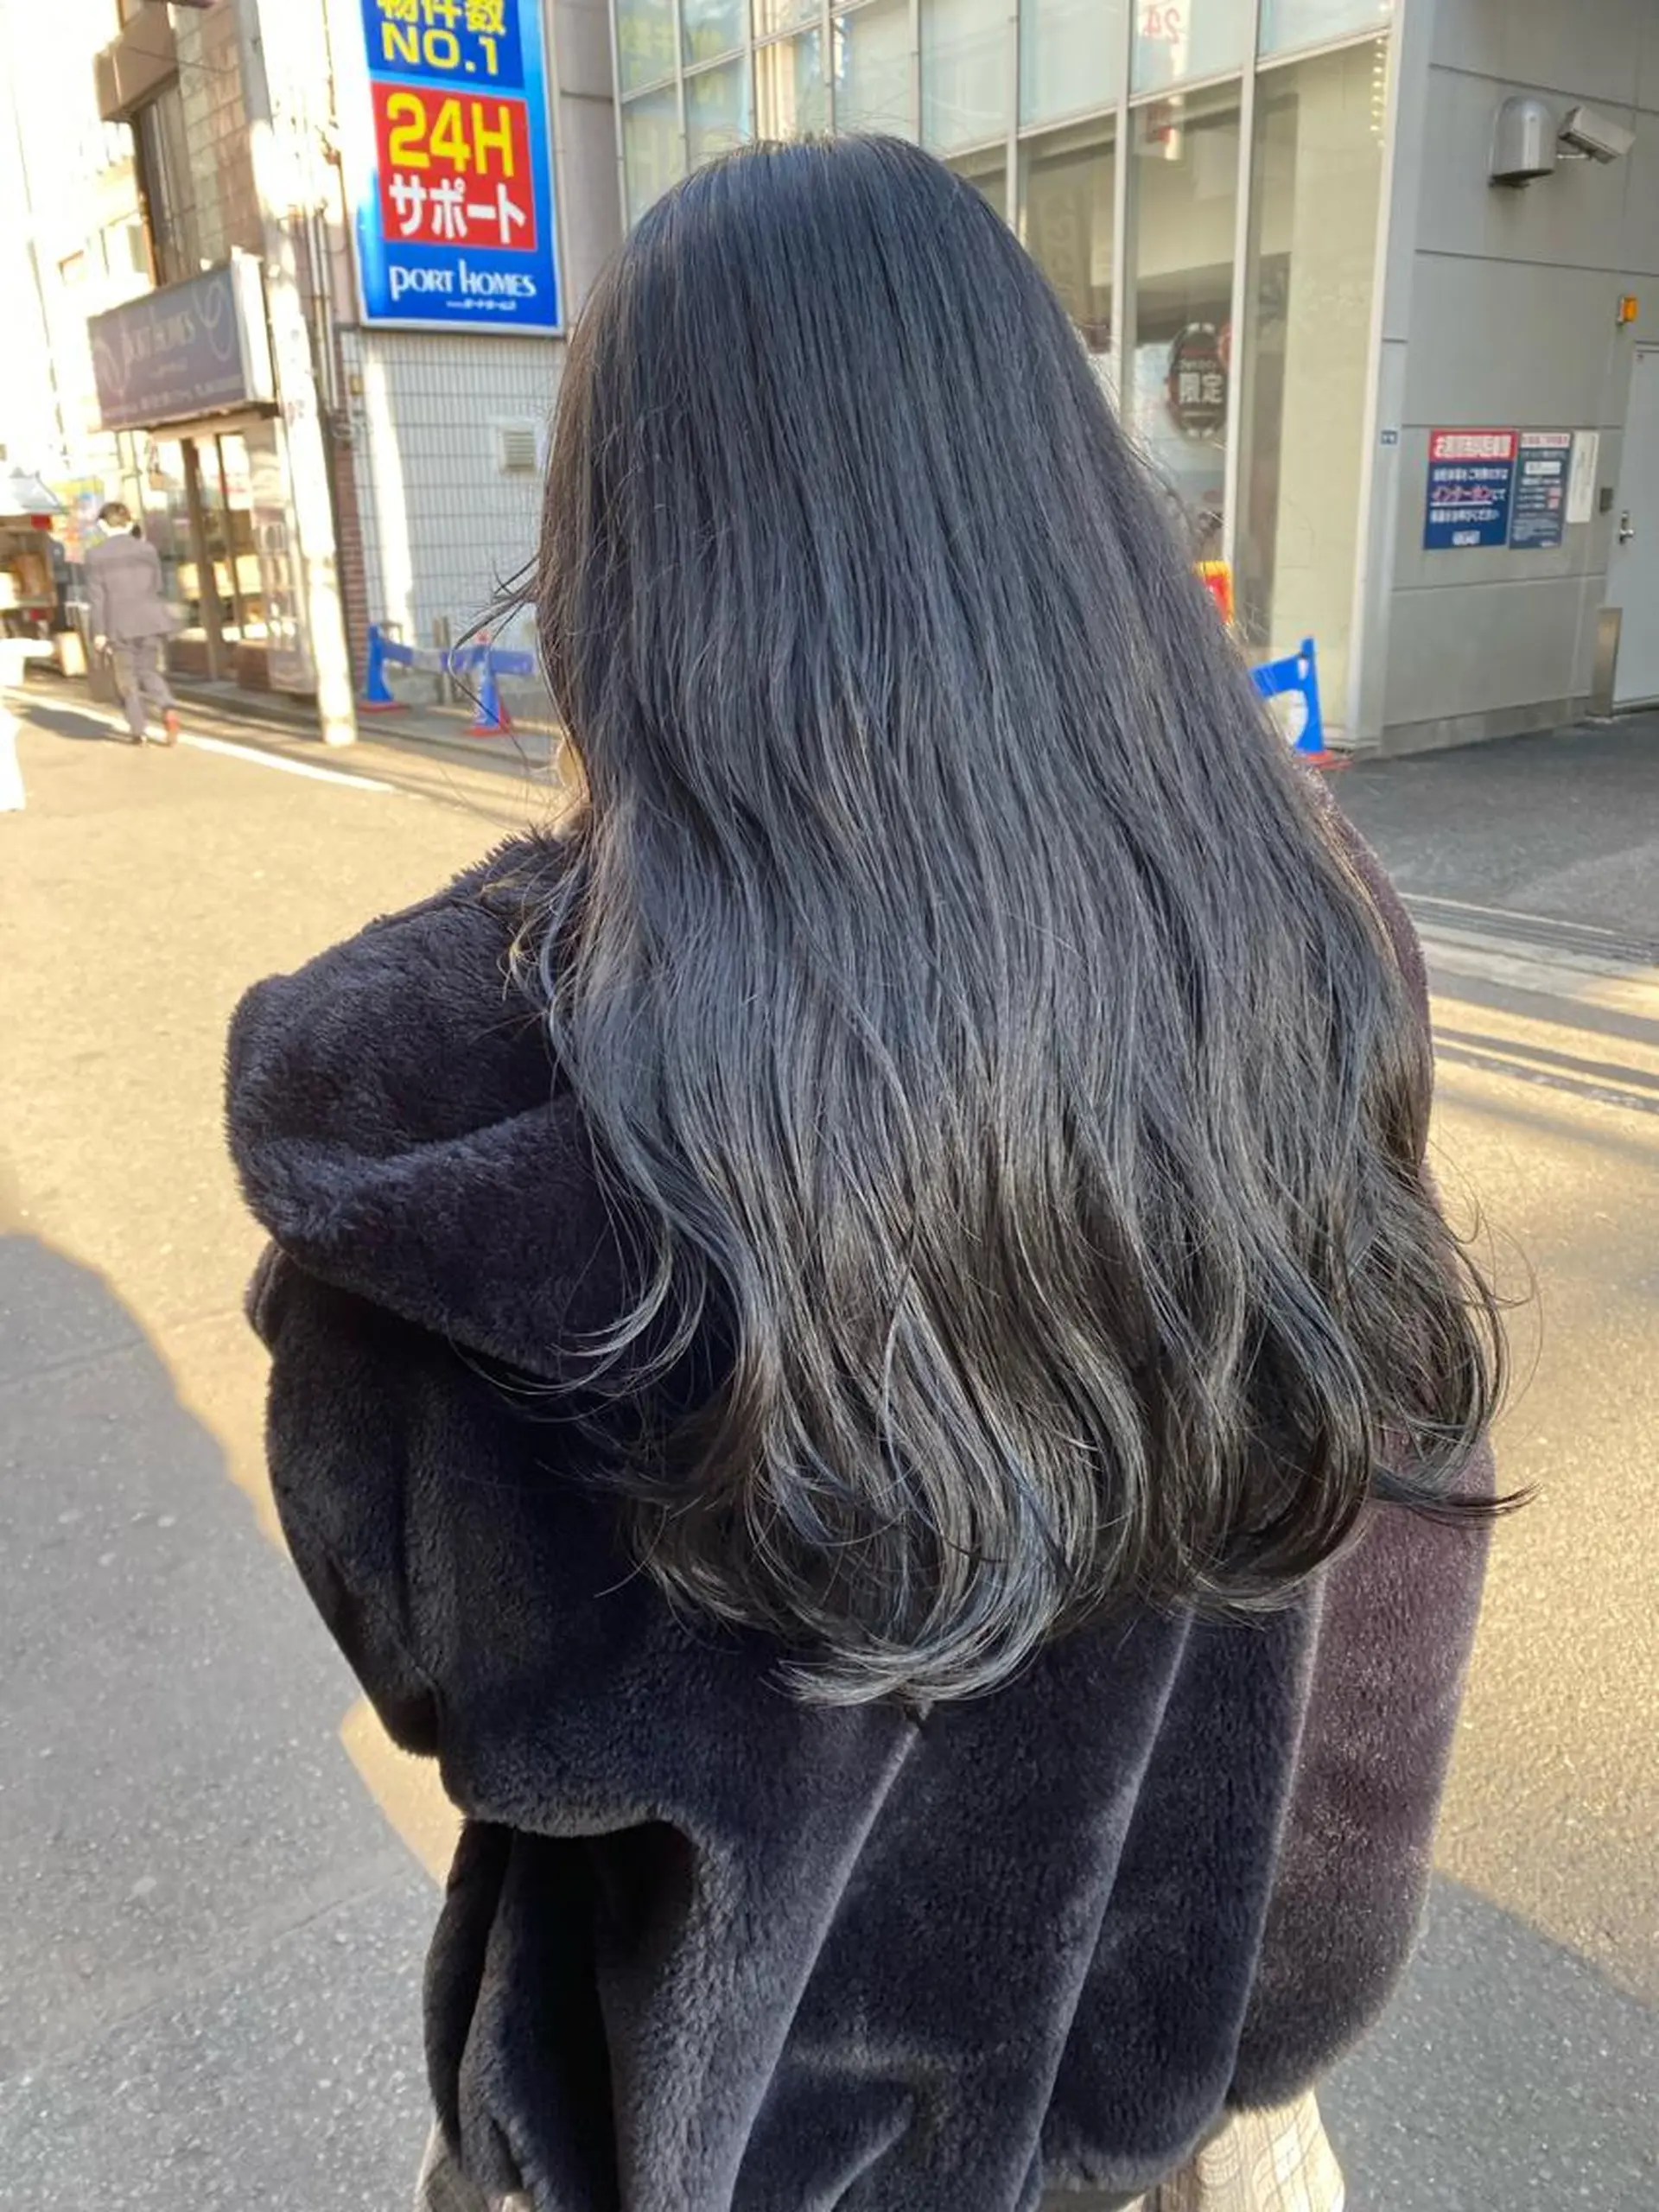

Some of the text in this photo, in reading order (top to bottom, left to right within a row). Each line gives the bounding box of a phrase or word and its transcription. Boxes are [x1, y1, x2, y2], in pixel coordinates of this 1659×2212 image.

[382, 21, 499, 75] NO.1
[386, 92, 514, 177] 24H
[388, 173, 526, 245] サポート
[389, 264, 454, 302] PORT
[1179, 372, 1224, 404] 限定
